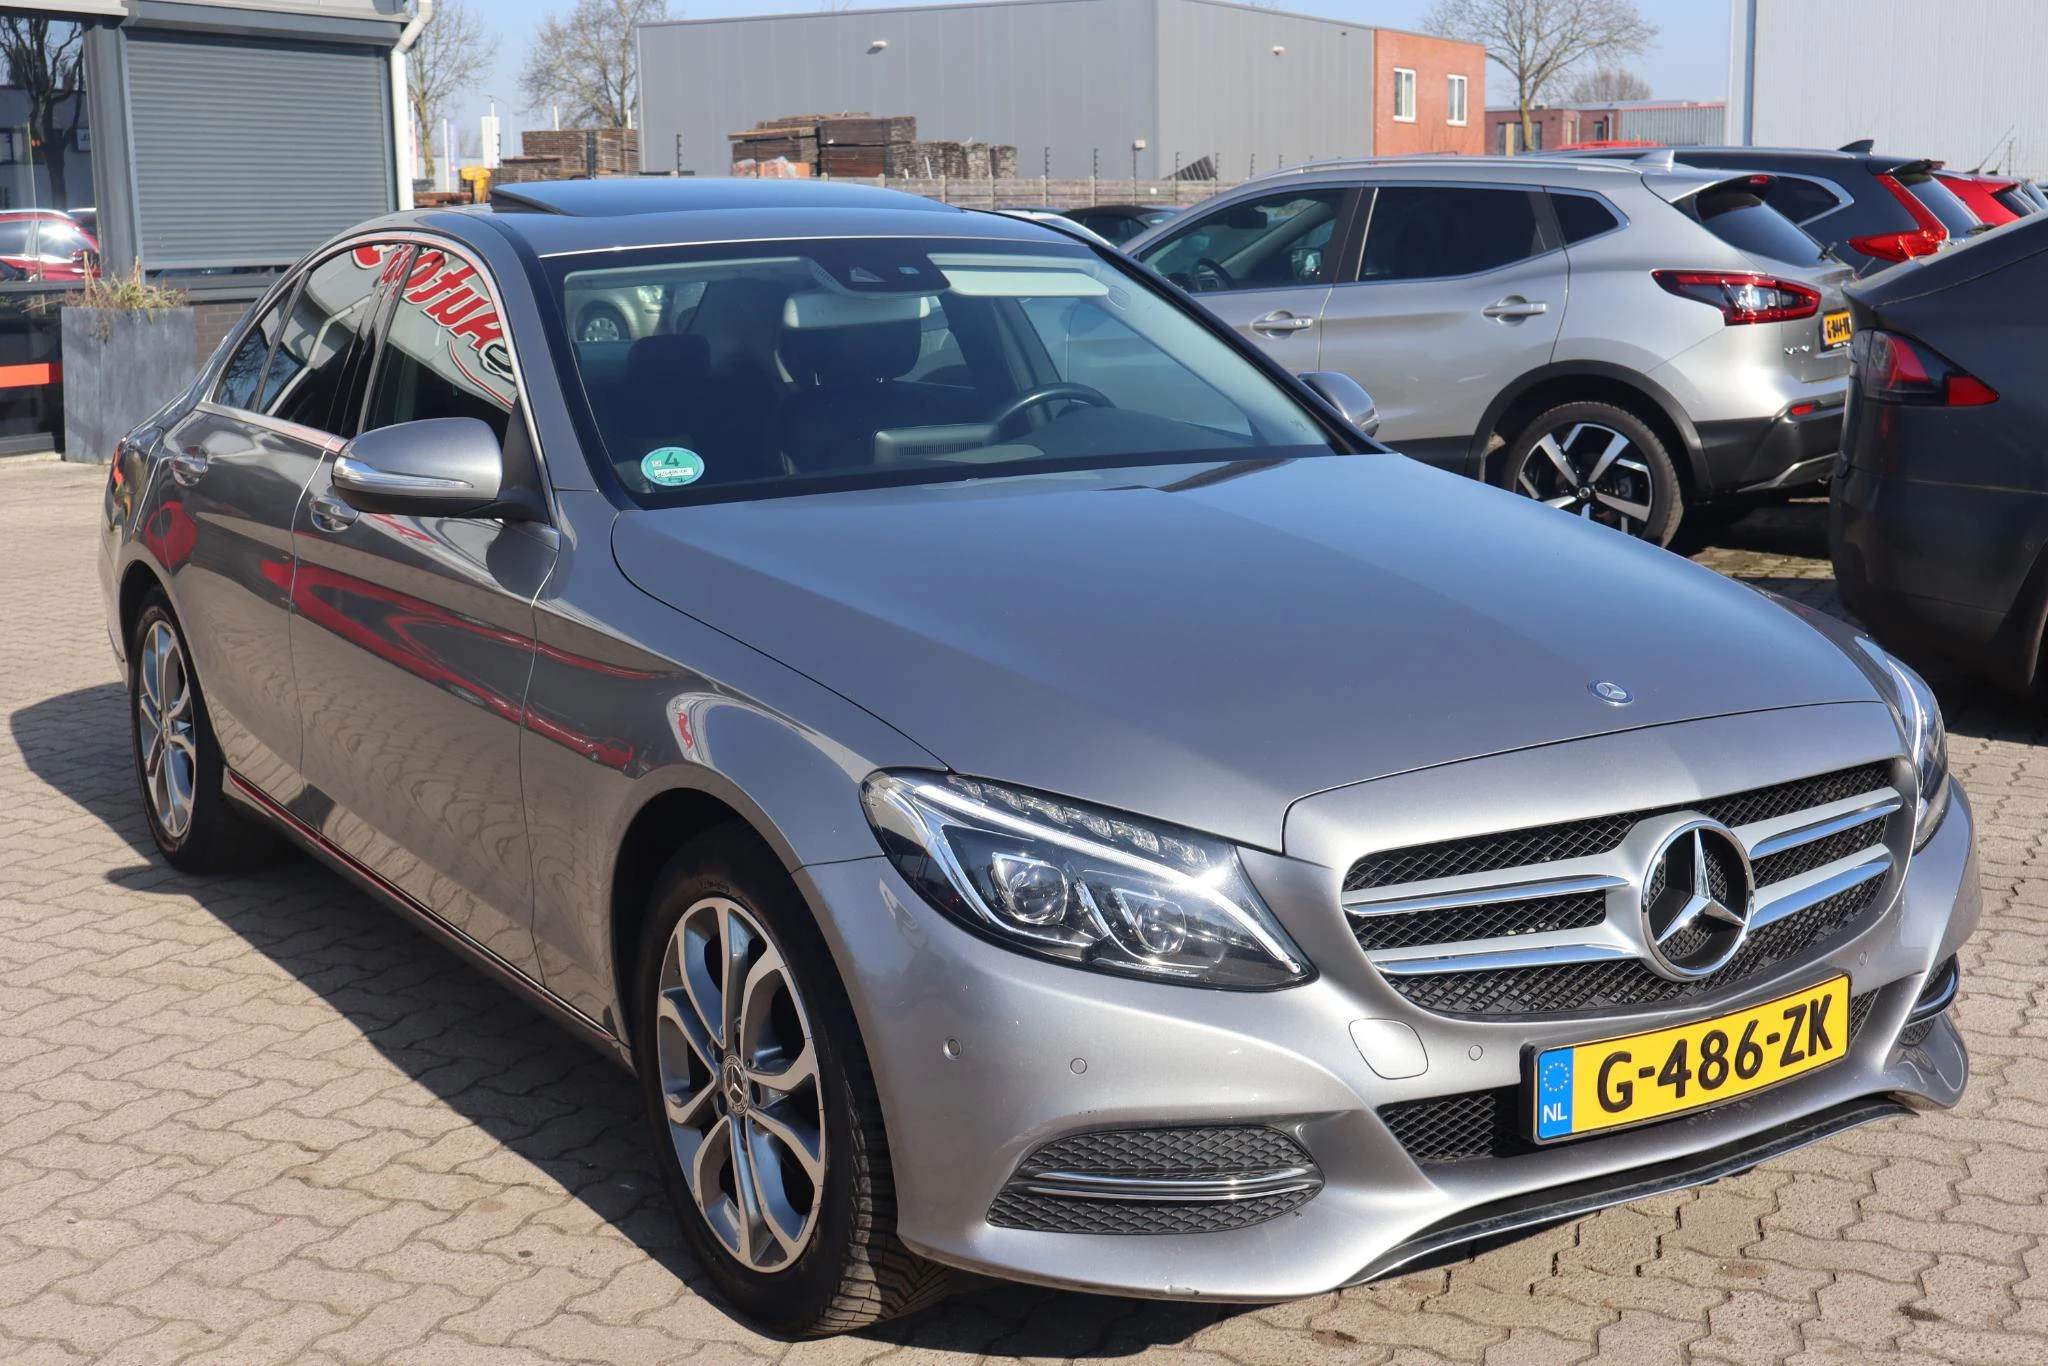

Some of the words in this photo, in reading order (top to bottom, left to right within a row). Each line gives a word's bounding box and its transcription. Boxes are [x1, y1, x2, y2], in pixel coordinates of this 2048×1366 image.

[664, 452, 680, 467] 4
[1597, 994, 1833, 1113] G-486-ZK
[1543, 1103, 1568, 1123] NL
